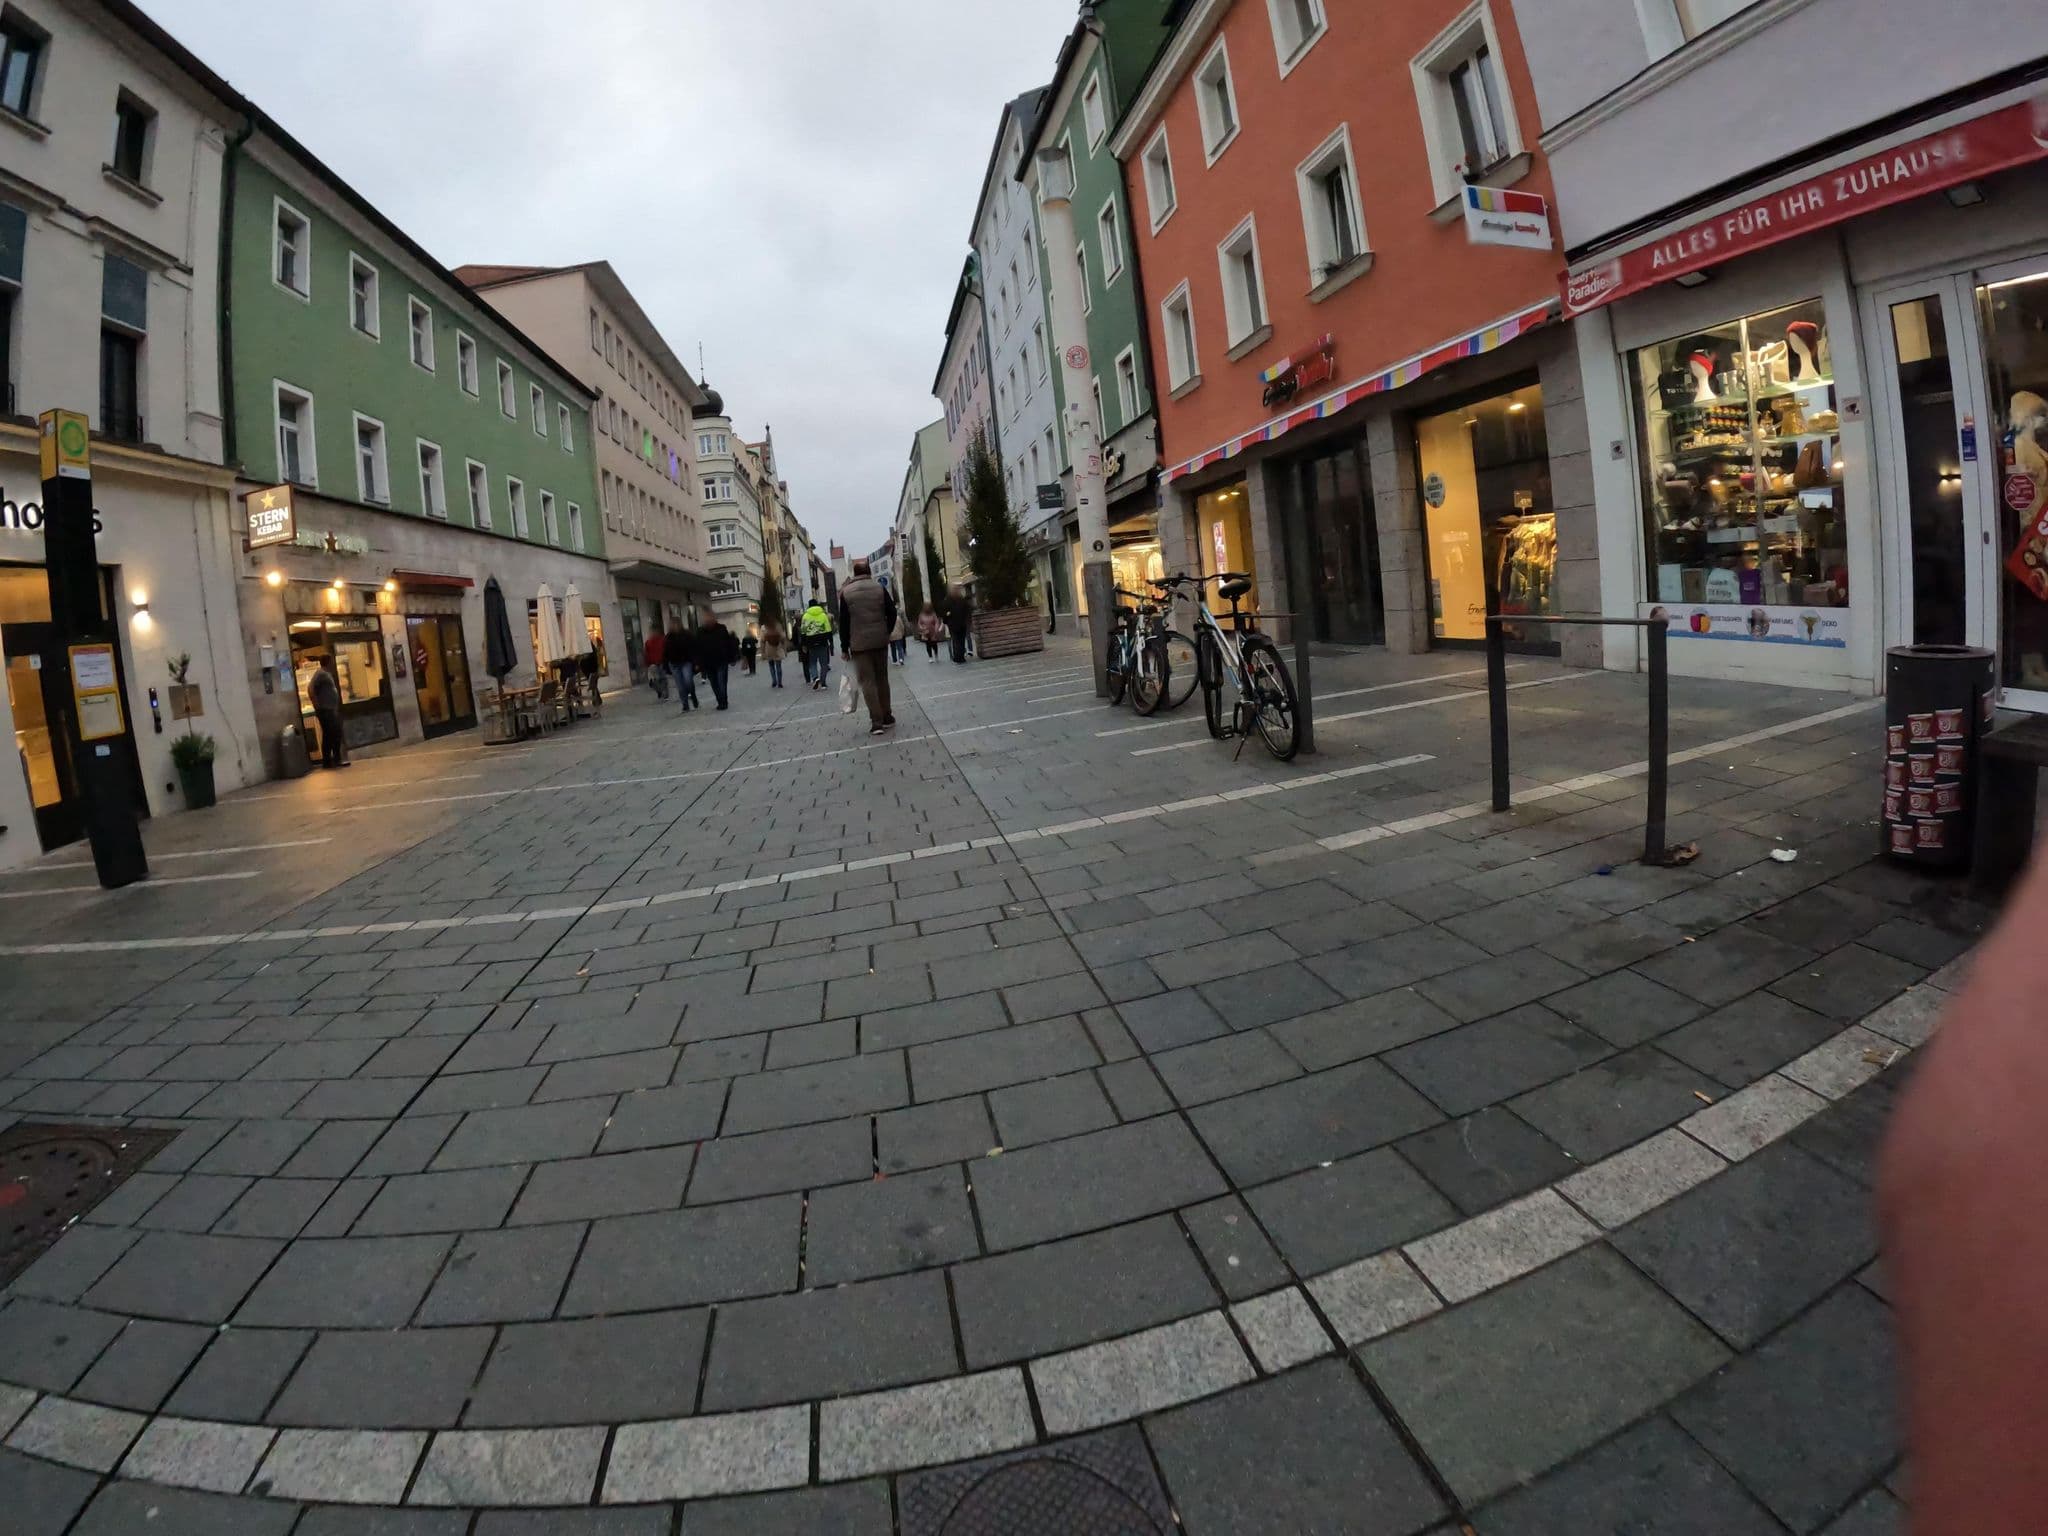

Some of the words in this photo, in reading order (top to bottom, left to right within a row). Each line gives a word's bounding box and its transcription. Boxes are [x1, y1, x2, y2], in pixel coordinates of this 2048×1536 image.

[1653, 226, 1717, 269] ALLES
[1724, 207, 1771, 241] FÜR
[1780, 186, 1825, 222] IHR
[1833, 132, 1969, 202] ZUHAUSE
[249, 507, 289, 529] STERN
[256, 522, 283, 536] KEBAB
